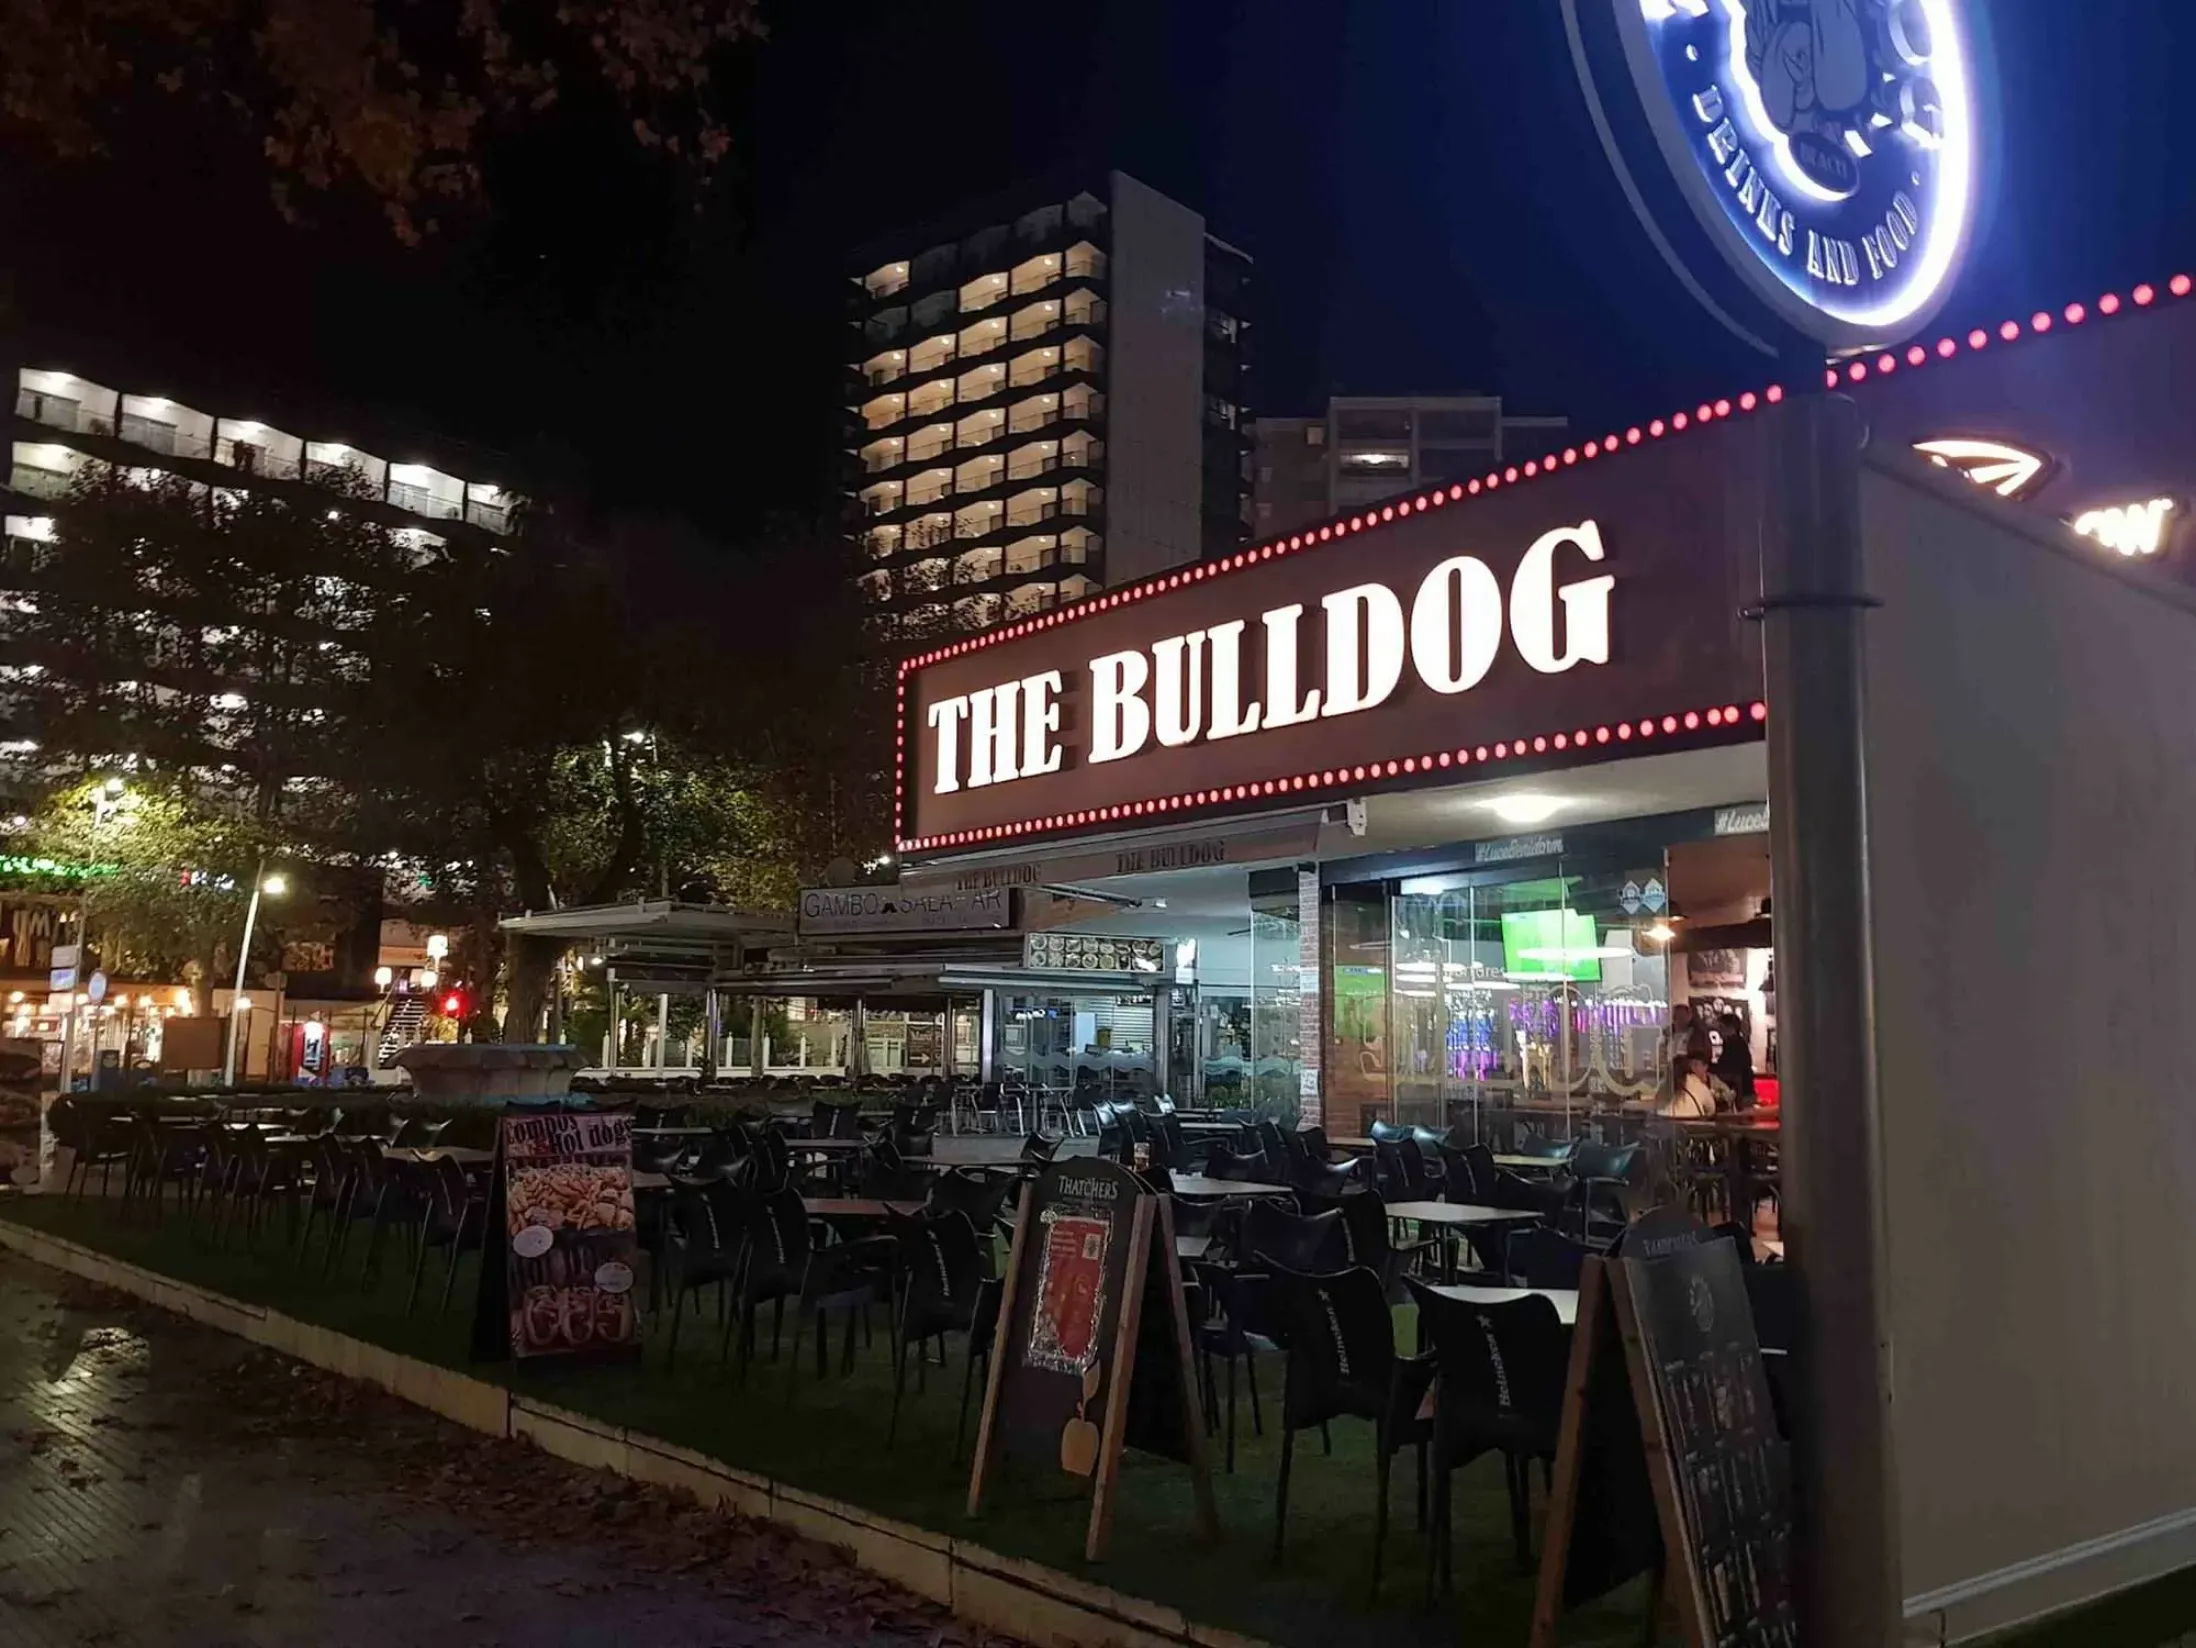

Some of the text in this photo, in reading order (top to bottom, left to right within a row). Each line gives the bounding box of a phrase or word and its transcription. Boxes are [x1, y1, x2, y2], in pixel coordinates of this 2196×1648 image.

[1692, 84, 1918, 286] DRINKS AND FOOD
[928, 519, 1616, 796] THE BULLDOG
[983, 864, 1042, 887] BULLDOG
[1116, 841, 1225, 873] THE BULLDOG
[804, 892, 879, 917] GAMBO
[900, 893, 963, 914] SALA
[1058, 1175, 1119, 1200] THATCHERS
[1326, 1305, 1350, 1376] Heineken
[1486, 1333, 1511, 1407] Heineken
